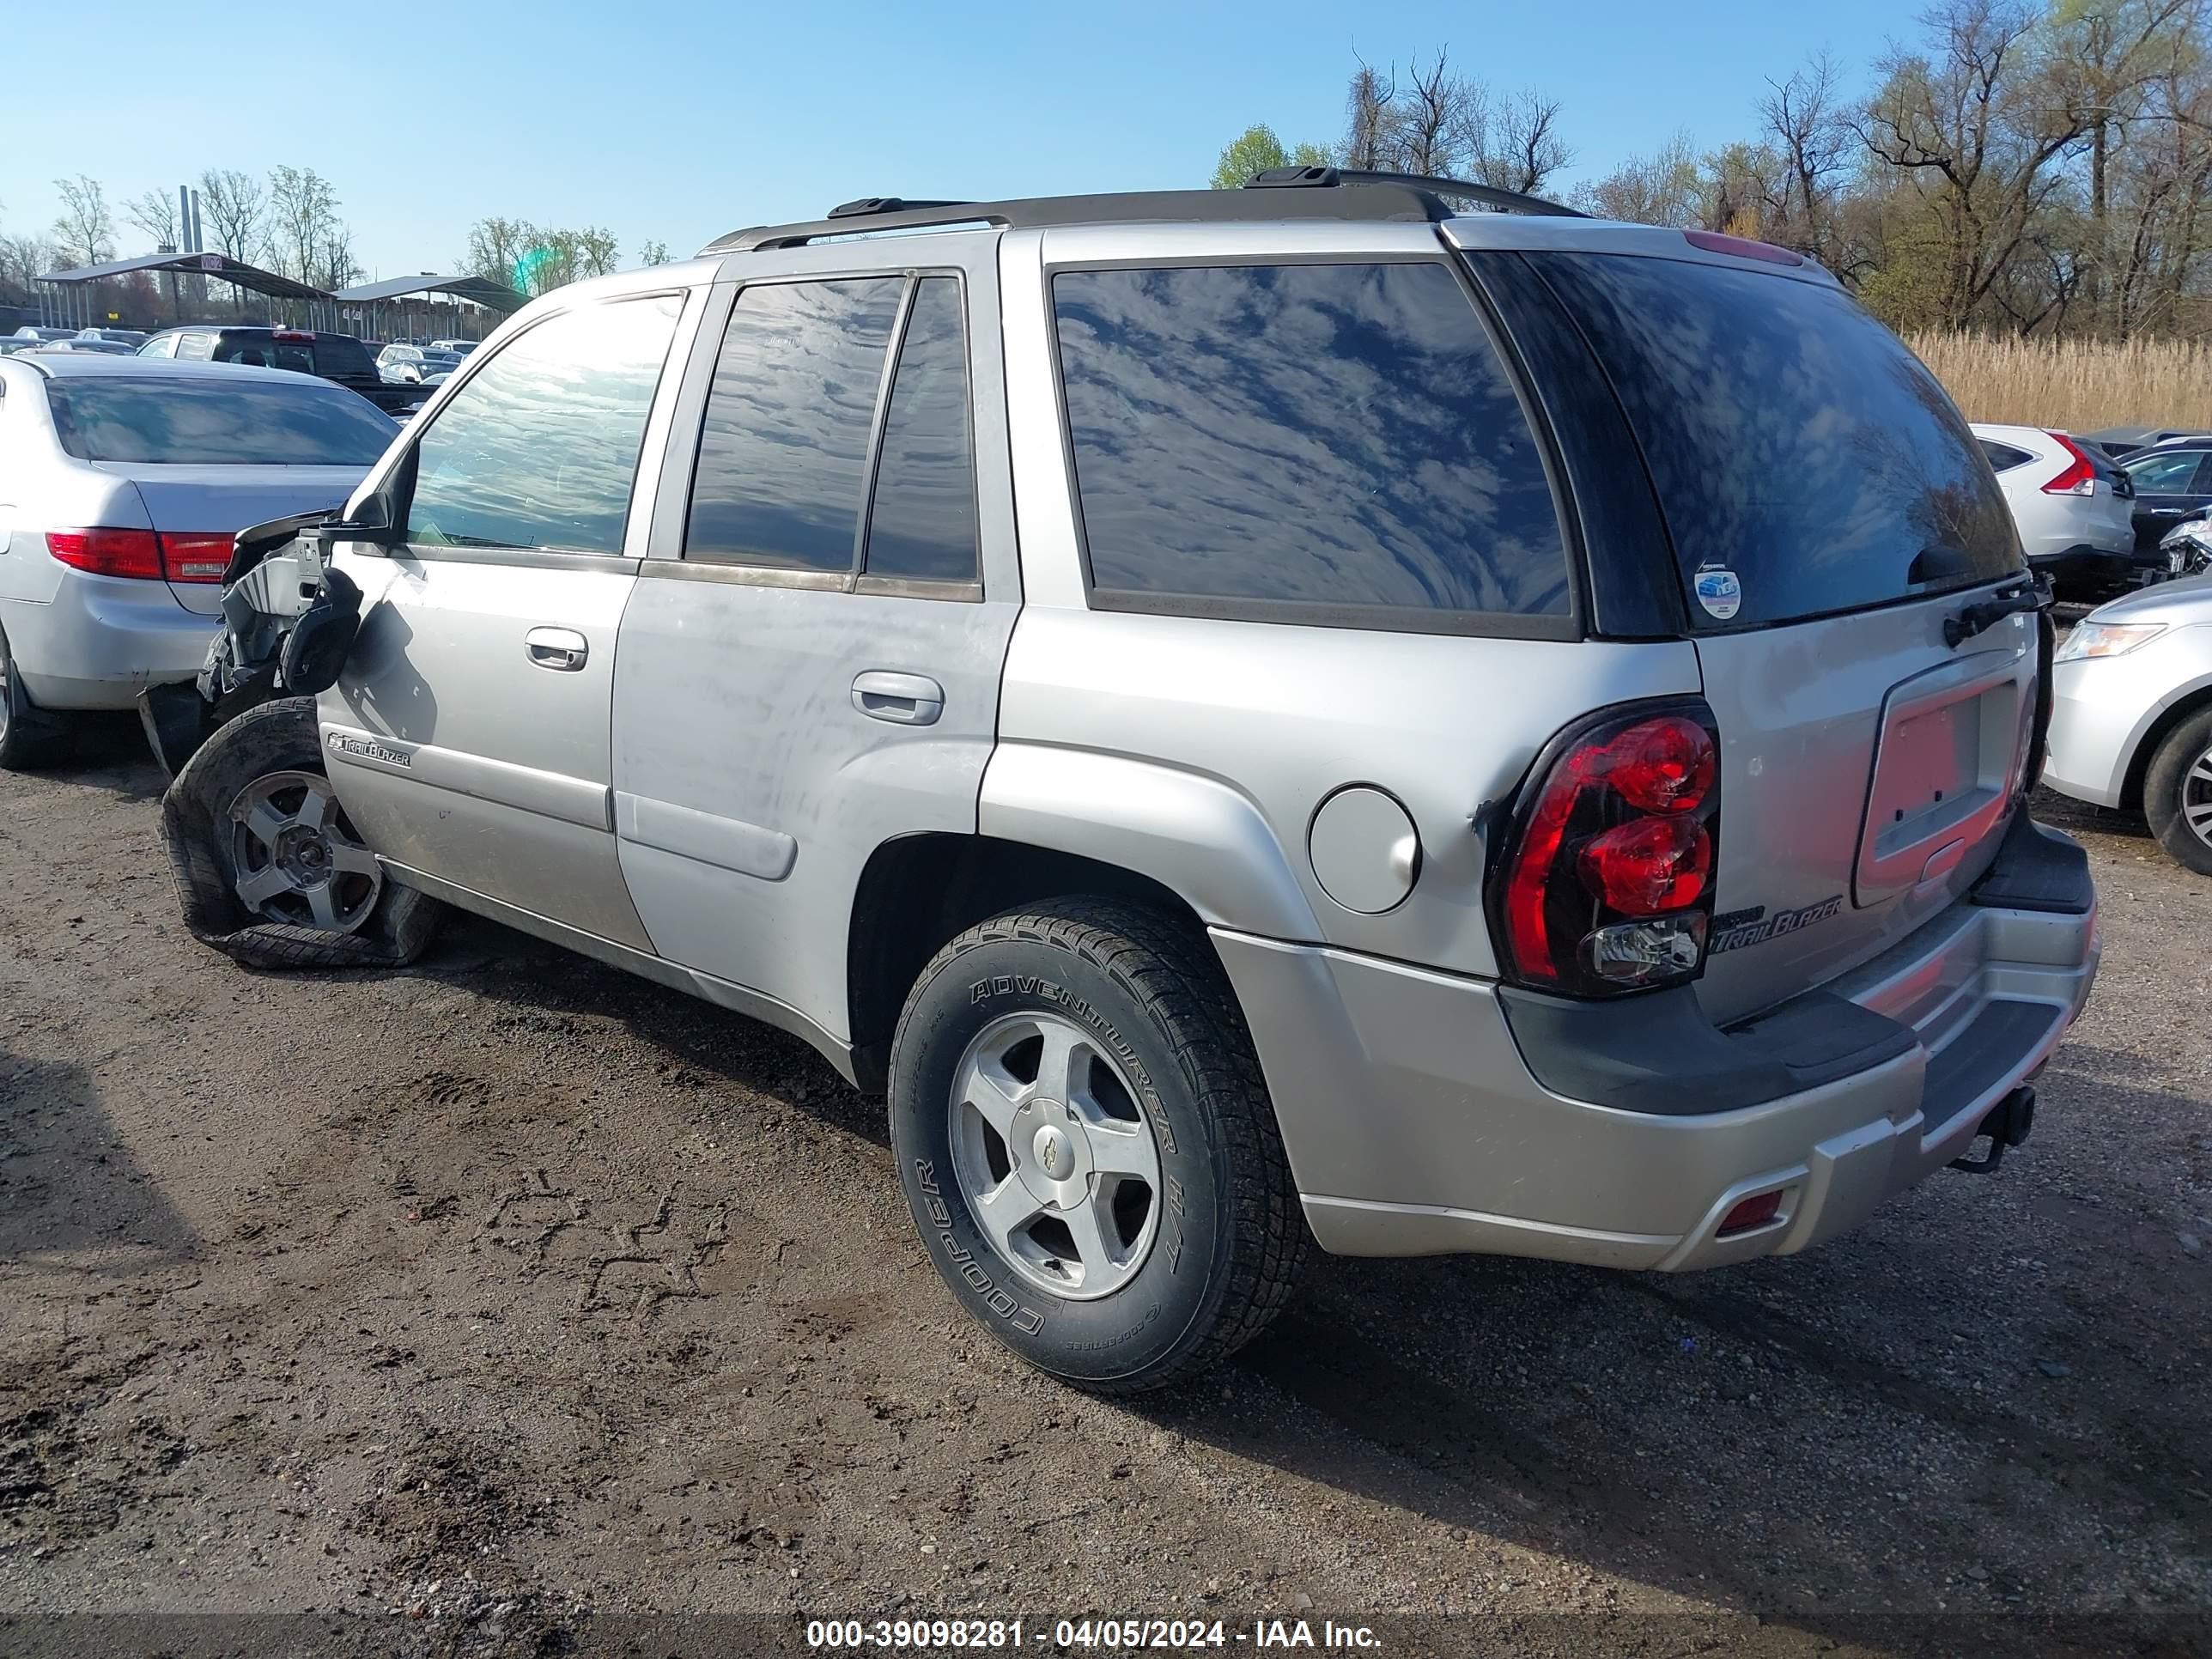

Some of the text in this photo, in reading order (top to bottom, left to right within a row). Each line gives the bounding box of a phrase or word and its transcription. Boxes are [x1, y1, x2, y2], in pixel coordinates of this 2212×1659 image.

[969, 975, 1179, 1154] ADVENTURER
[1166, 1175, 1184, 1274] H/T
[915, 1158, 1045, 1336] COOPER
